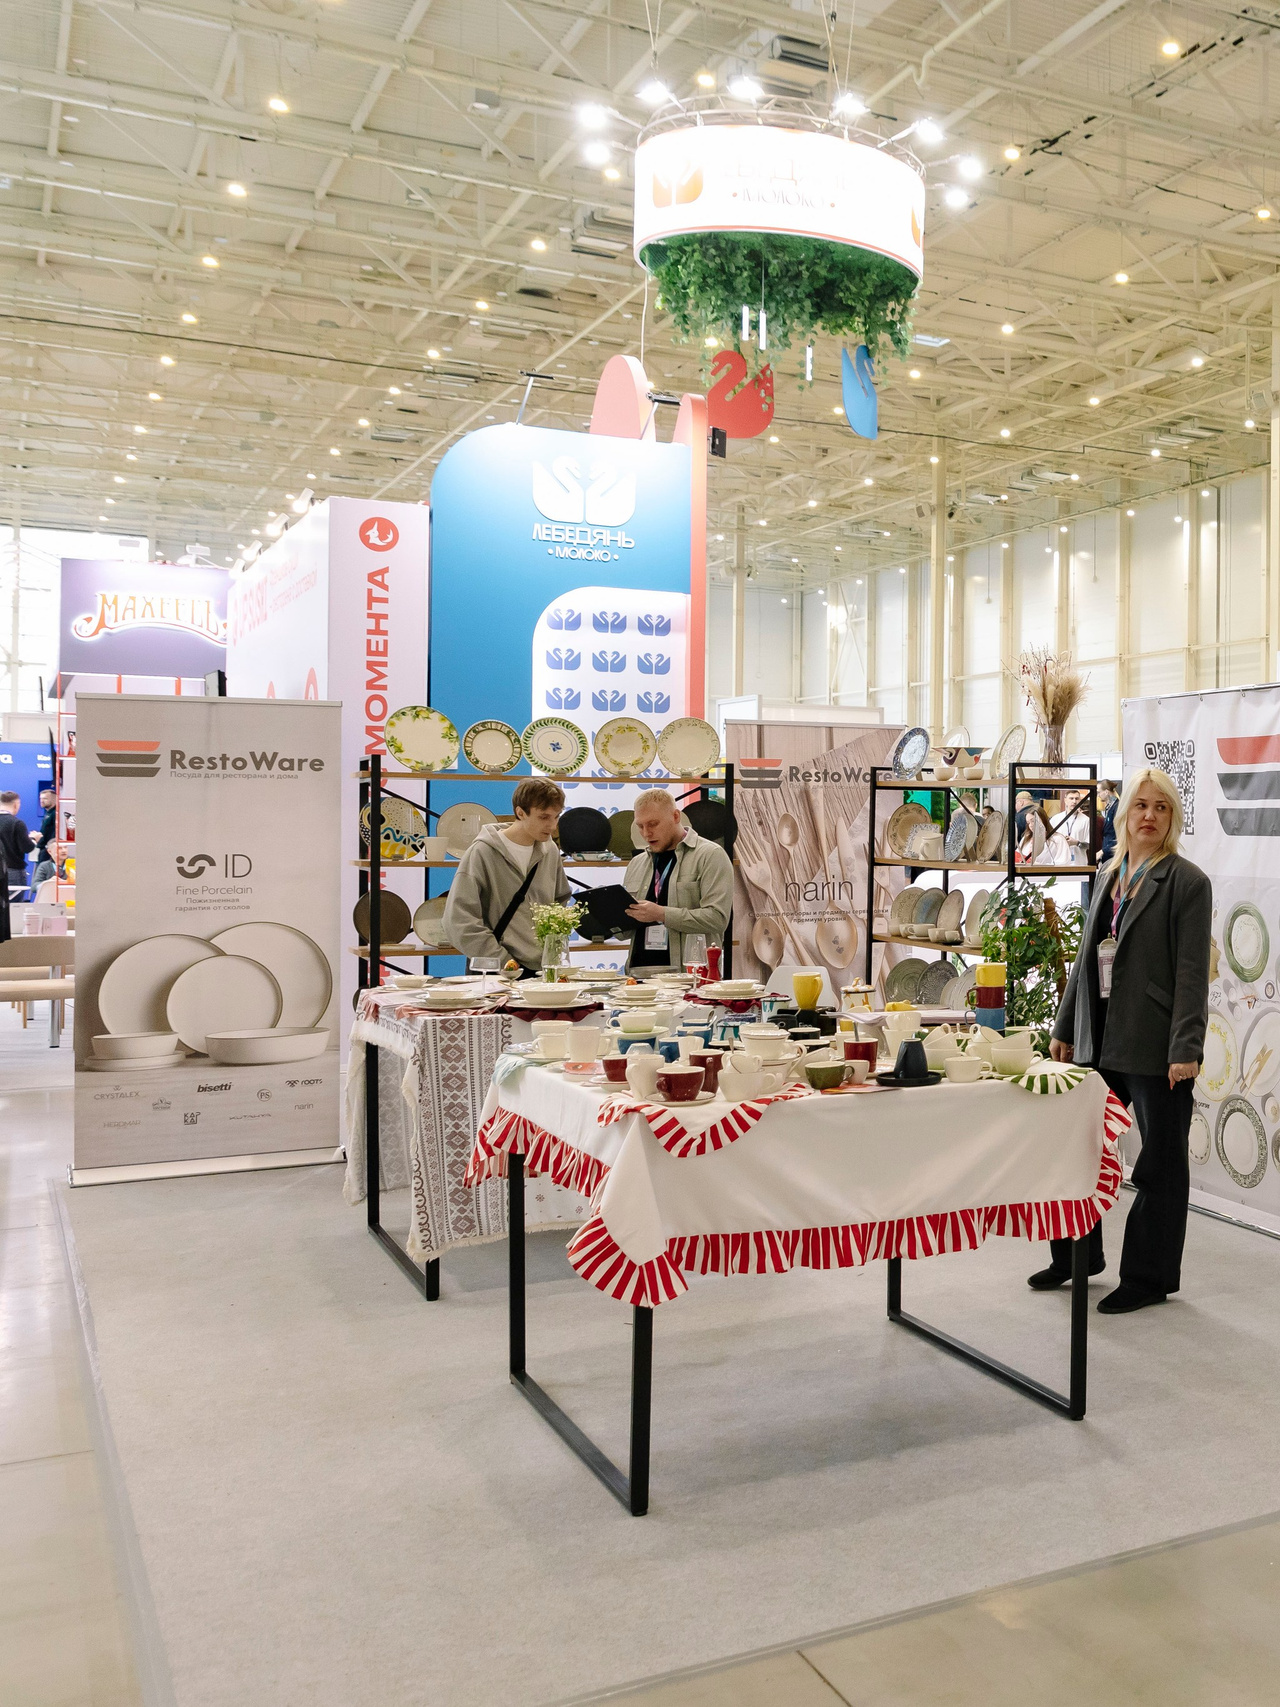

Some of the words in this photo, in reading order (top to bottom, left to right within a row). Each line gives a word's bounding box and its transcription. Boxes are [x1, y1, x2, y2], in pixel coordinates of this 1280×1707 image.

[532, 523, 635, 549] ЛЕБЕДЯНЬ
[555, 546, 611, 562] МОЛОКО
[364, 565, 390, 756] МОМЕНТА
[170, 749, 325, 772] RestoWare
[170, 771, 202, 779] Посуда
[222, 772, 268, 780] ресторана
[225, 853, 252, 878] ID
[176, 885, 199, 895] Fine
[201, 885, 253, 895] Porcelain
[785, 874, 854, 902] narin
[852, 908, 889, 916] сервовки
[197, 1082, 233, 1093] bisetti
[93, 1091, 141, 1101] CRYSTALEX
